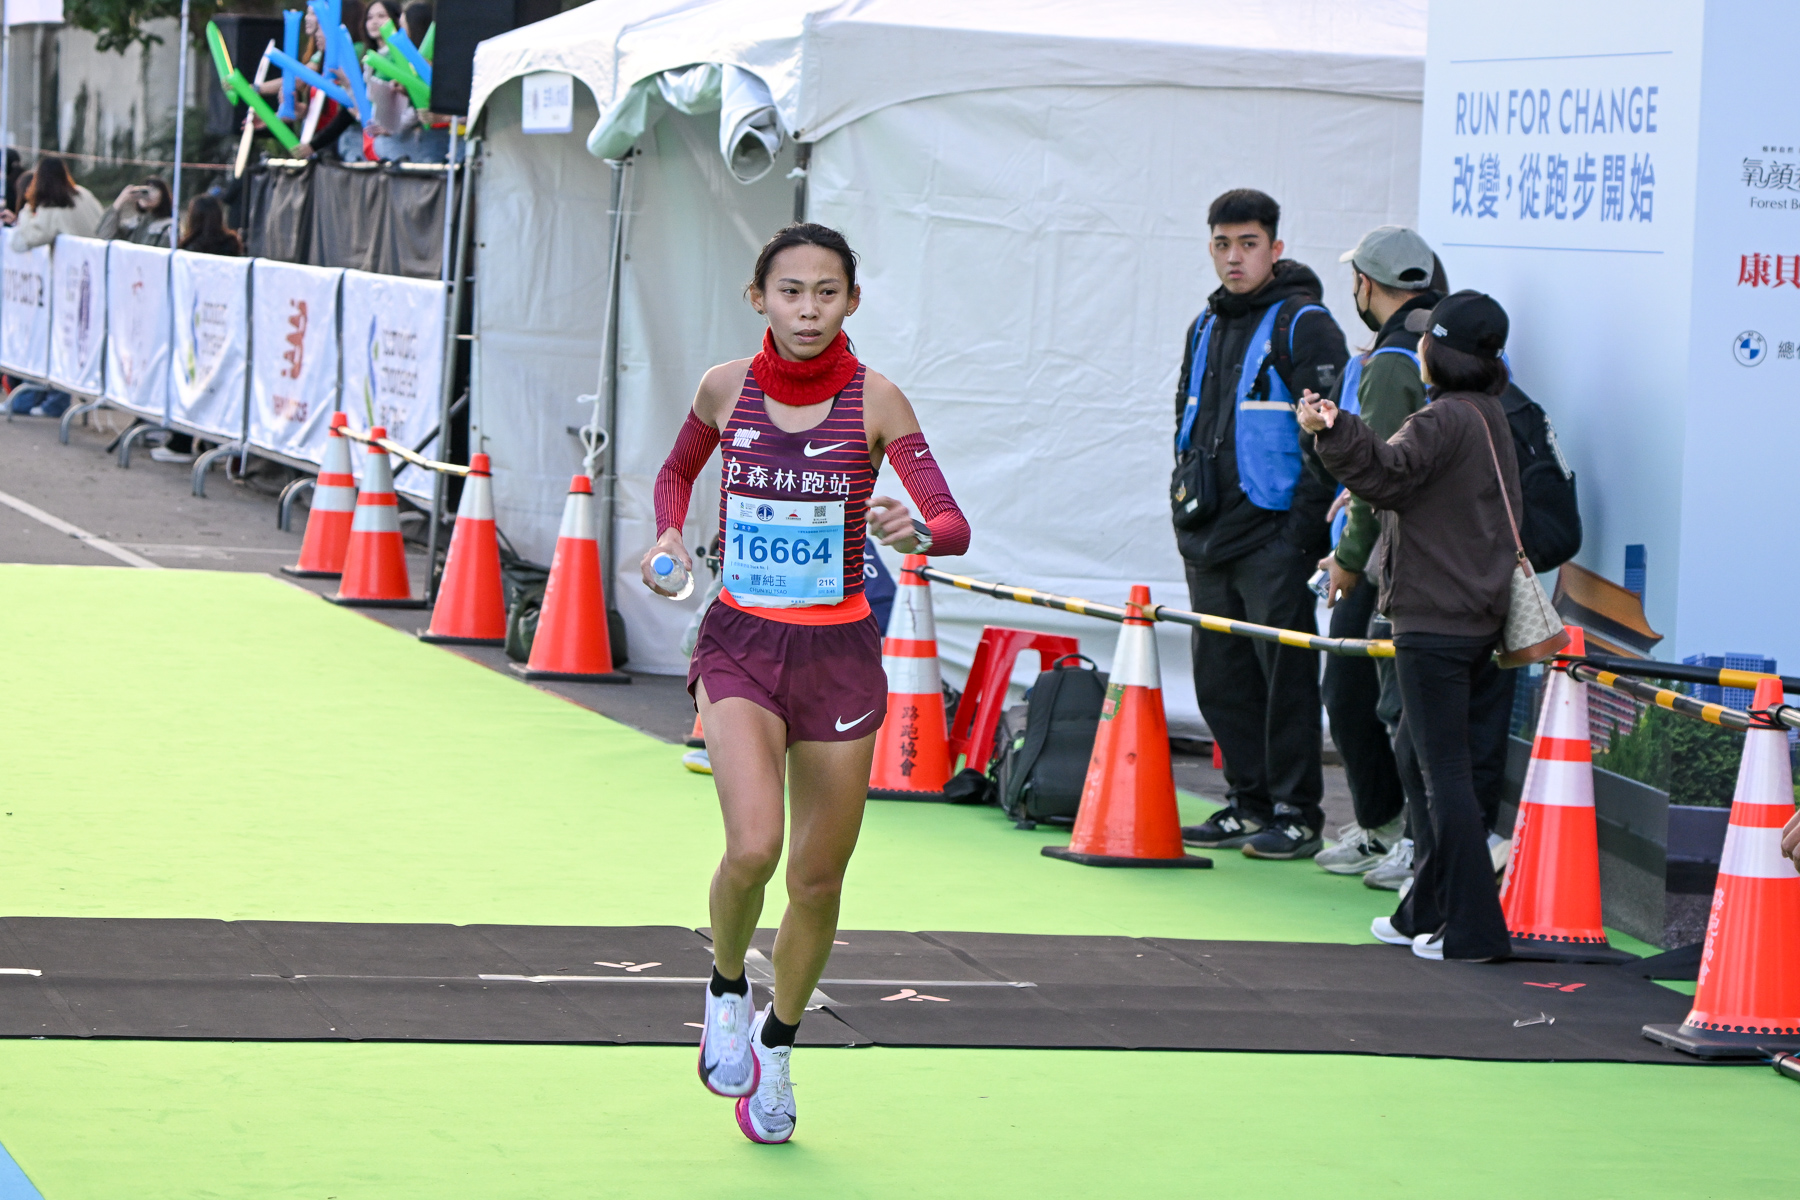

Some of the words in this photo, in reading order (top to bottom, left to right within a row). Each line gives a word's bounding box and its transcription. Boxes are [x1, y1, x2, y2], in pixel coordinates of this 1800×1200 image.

[1456, 90, 1500, 135] RUN
[1507, 87, 1551, 135] FOR
[1559, 85, 1659, 135] CHANGE
[1750, 196, 1788, 210] Forest
[1777, 341, 1800, 360] 總
[732, 533, 833, 566] 16664
[750, 573, 788, 587] 曹純玉
[818, 578, 835, 587] 21K
